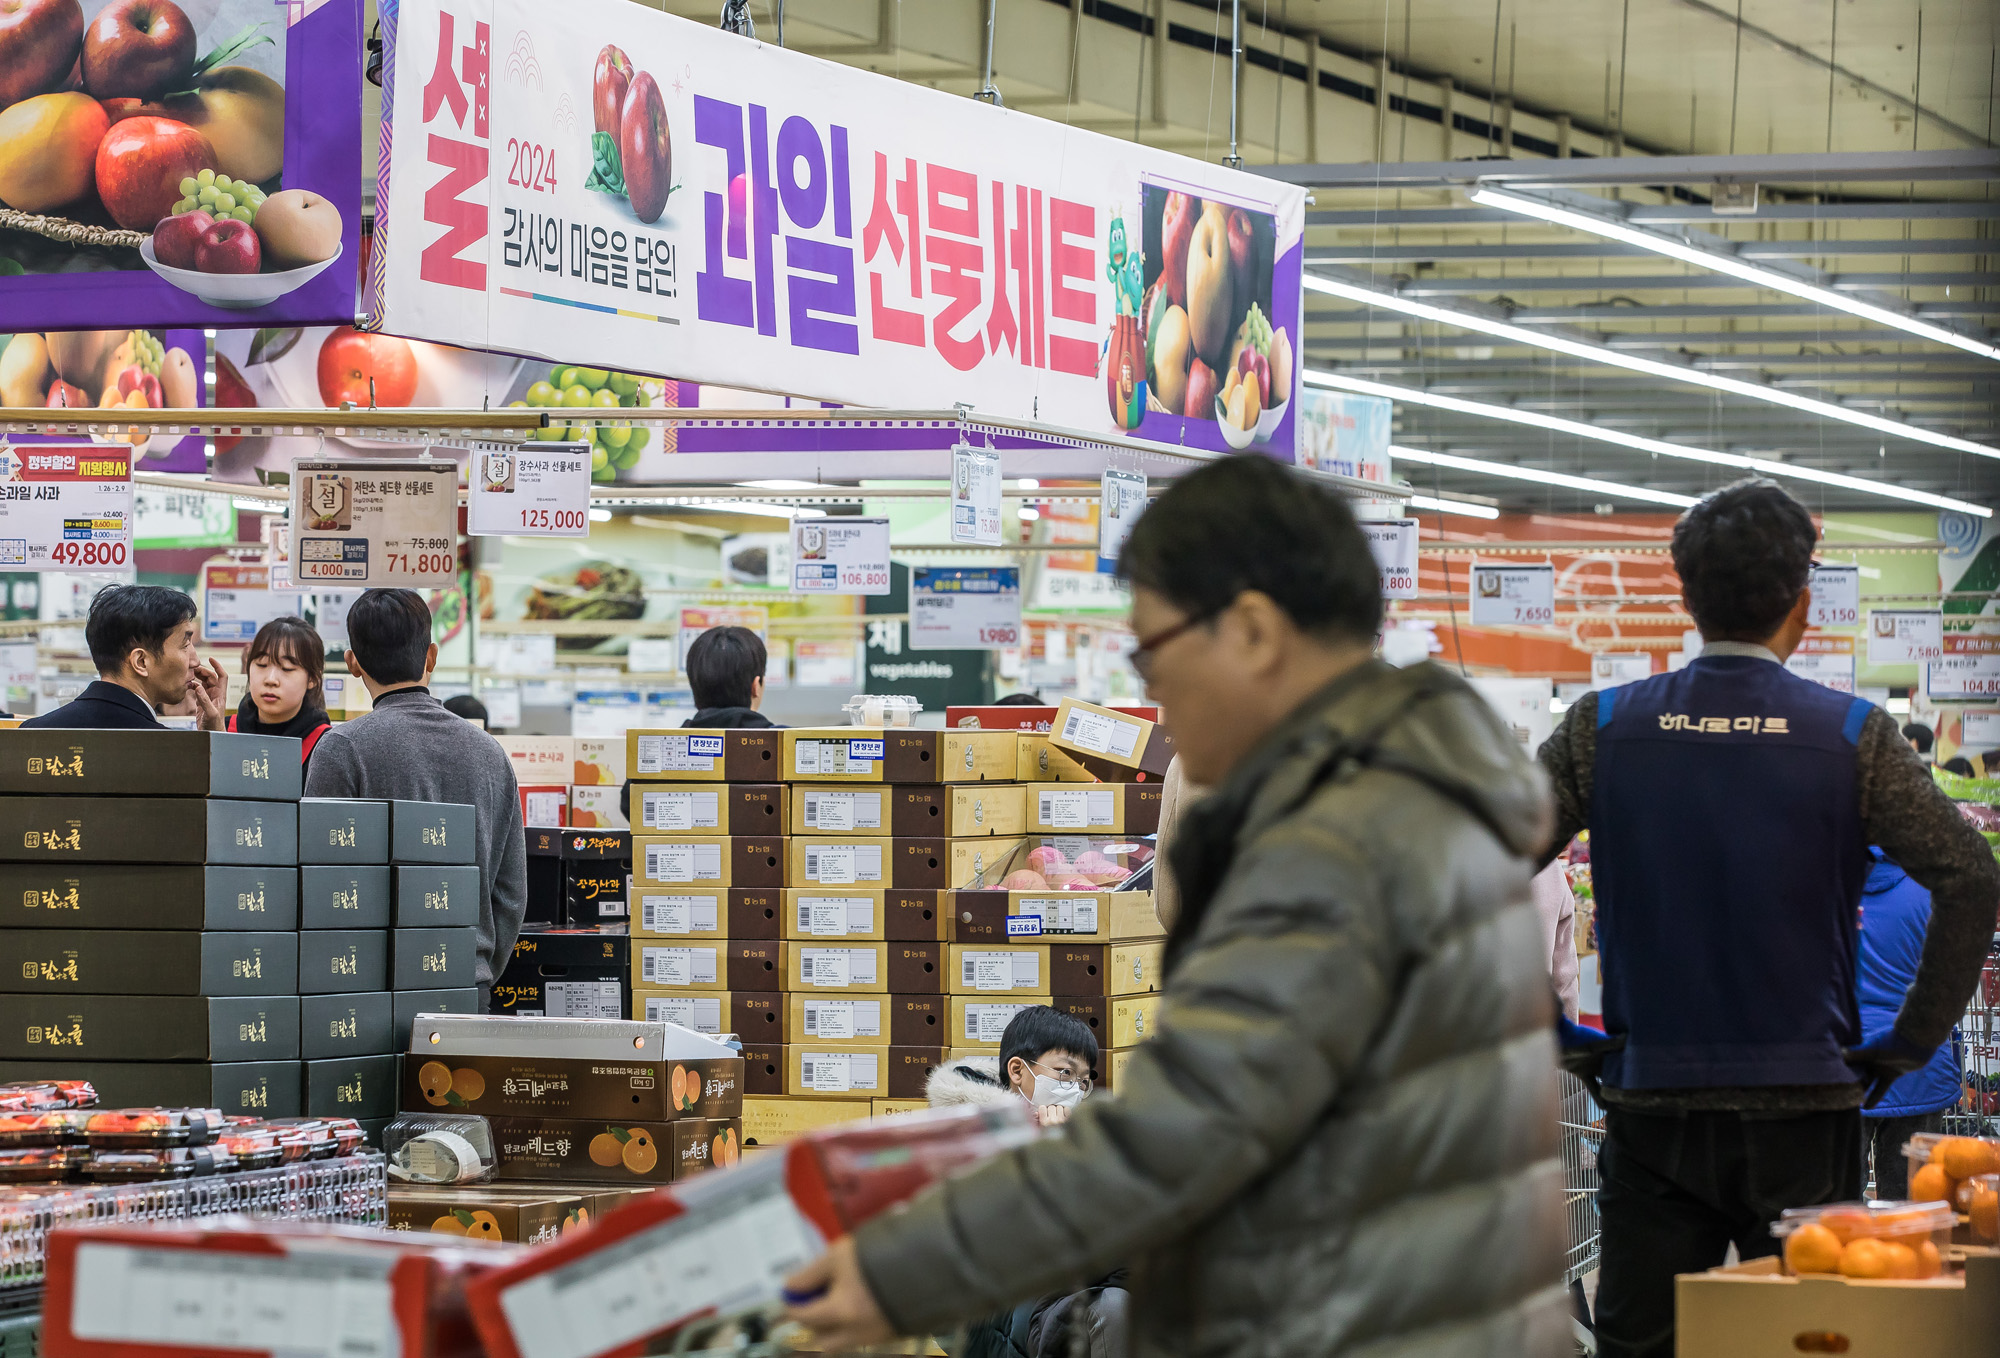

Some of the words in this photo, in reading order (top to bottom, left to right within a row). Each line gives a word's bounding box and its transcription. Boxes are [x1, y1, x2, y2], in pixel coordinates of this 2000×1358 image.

[420, 10, 489, 292] 설
[507, 137, 557, 195] 2024
[693, 93, 859, 356] 과일
[862, 150, 1099, 379] 선물세트
[504, 207, 563, 277] 감사의
[570, 223, 628, 289] 마음을
[28, 455, 76, 470] 정부할인
[79, 461, 127, 476] 지원행사
[519, 460, 549, 472] 장수사과
[552, 461, 582, 473] 선물세트
[35, 486, 60, 501] 사과
[318, 486, 335, 509] 설
[354, 481, 376, 495] 저탄소
[380, 481, 402, 495] 레드향
[404, 481, 434, 496] 선물세트
[521, 509, 585, 530] 125,000
[93, 531, 110, 539] 4,000
[411, 538, 449, 550] 75,800
[51, 542, 126, 566] 49,800
[310, 564, 343, 576] 4,000
[387, 554, 453, 576] 71,800
[841, 573, 888, 585] 106,800
[1514, 607, 1551, 622] 7,650
[1818, 608, 1856, 624] 5,150
[979, 628, 1017, 643] 1,980
[1907, 646, 1940, 659] 7,580
[870, 660, 953, 682] vegetables
[1658, 713, 1790, 735] 하나로마트
[692, 739, 720, 748] 냉장보관
[853, 743, 881, 752] 냉장보관
[1010, 924, 1038, 933] 냉장보관
[503, 1078, 569, 1098] 달코미레드향
[503, 1136, 572, 1157] 달코미레드향
[681, 1140, 709, 1160] 달코미레드향
